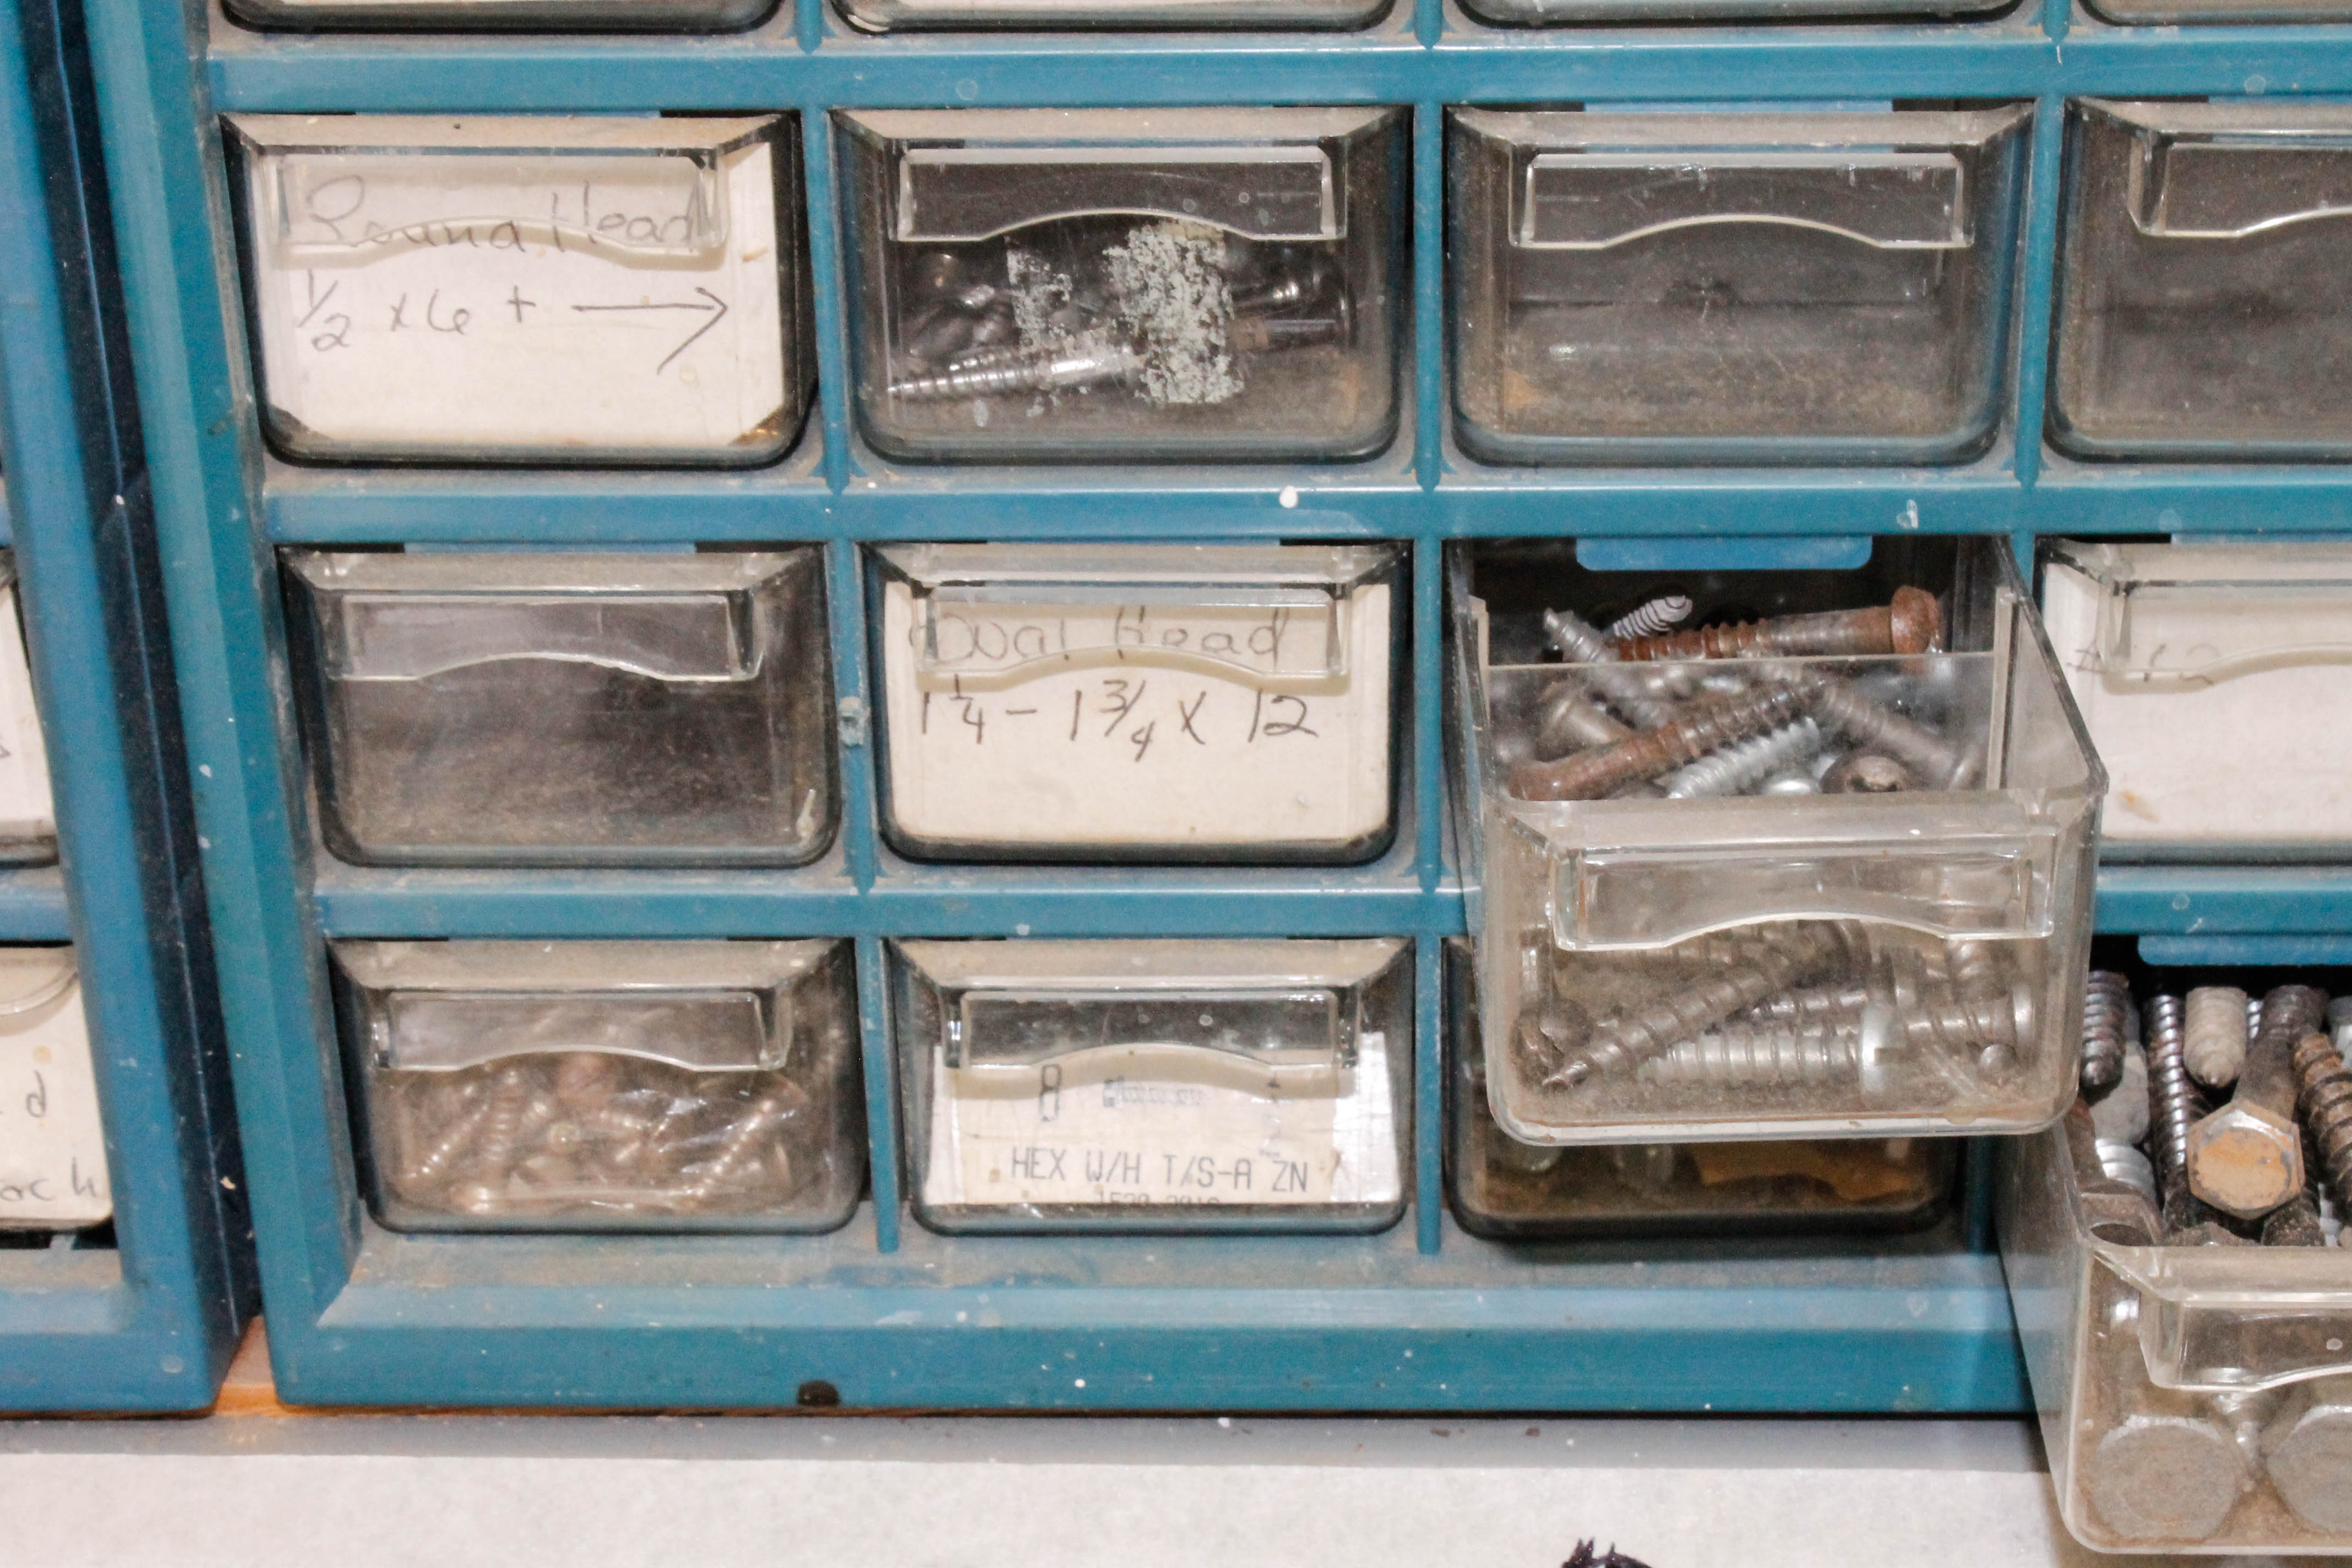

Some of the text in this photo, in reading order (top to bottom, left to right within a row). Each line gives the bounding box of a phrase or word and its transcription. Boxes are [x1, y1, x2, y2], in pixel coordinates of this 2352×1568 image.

[1246, 688, 1319, 743] 12
[1011, 1146, 1309, 1193] HEX W/H T/S-A ZN
